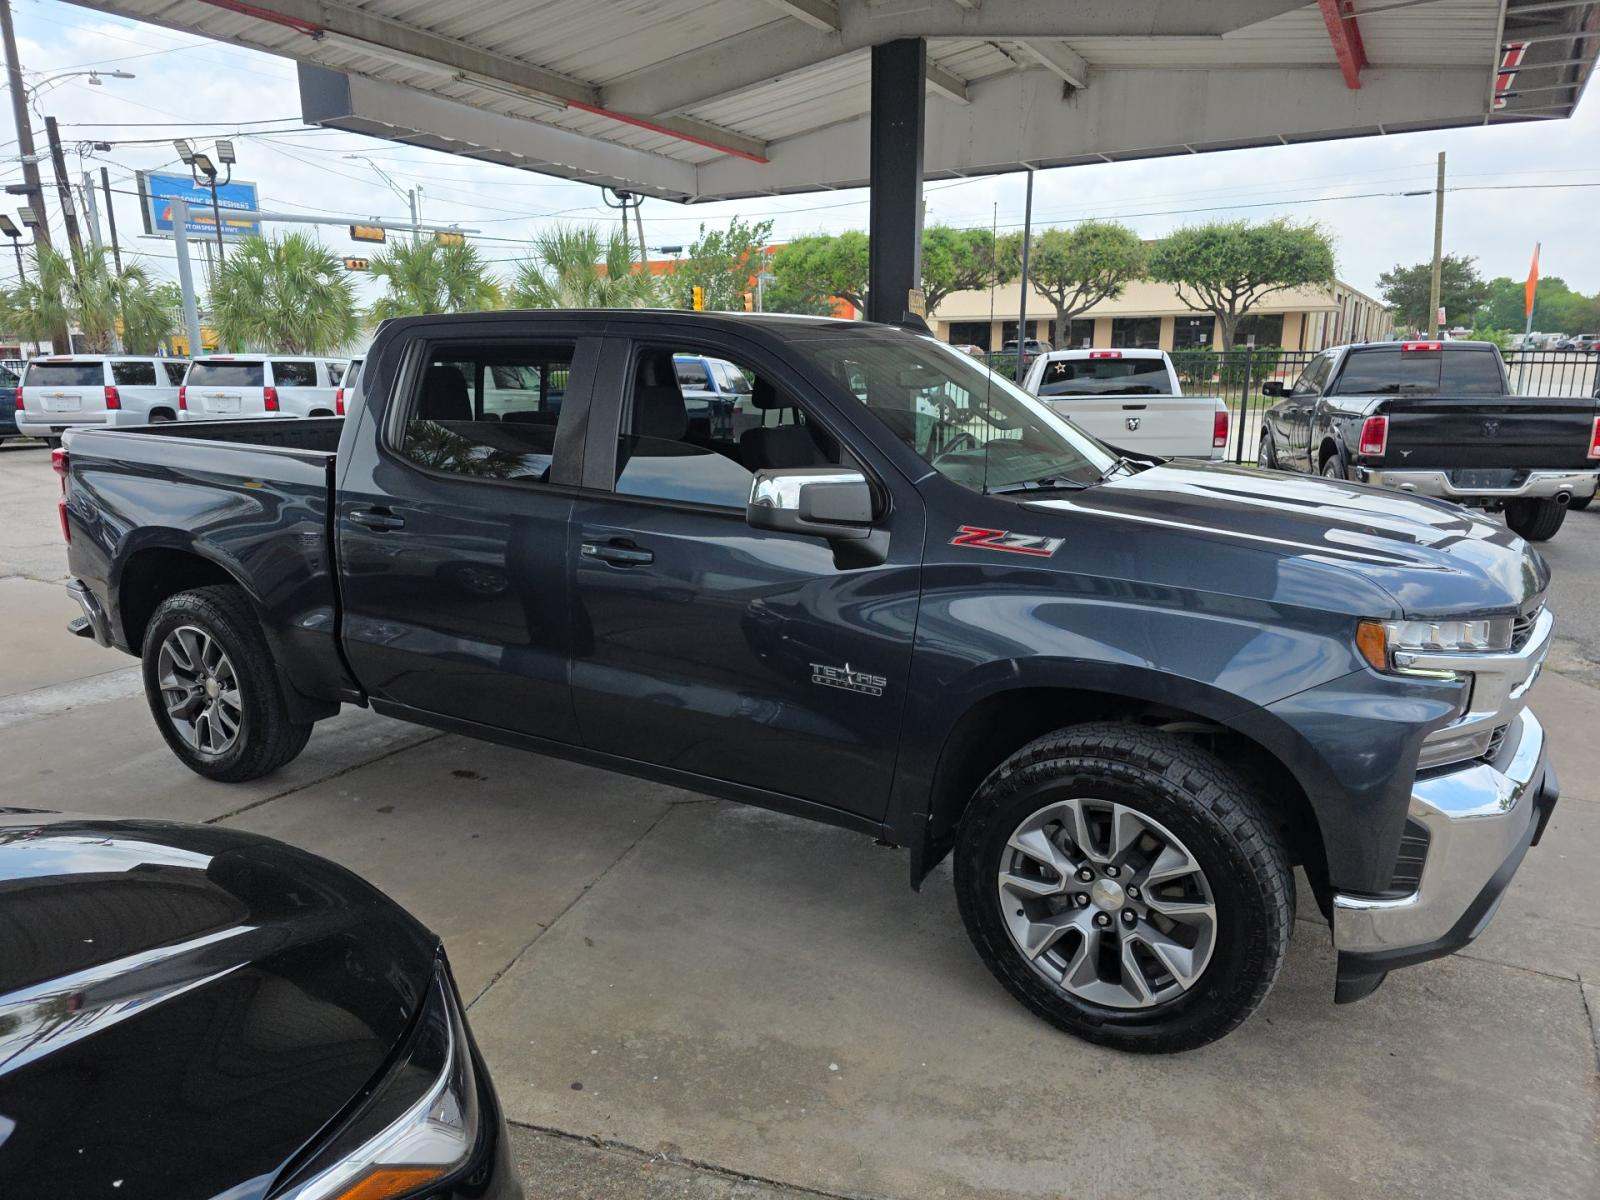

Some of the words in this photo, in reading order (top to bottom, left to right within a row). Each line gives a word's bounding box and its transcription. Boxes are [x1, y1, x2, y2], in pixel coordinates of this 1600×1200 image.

[181, 196, 204, 205] SONIC
[947, 524, 1066, 558] Z71
[809, 662, 887, 687] TEXAS
